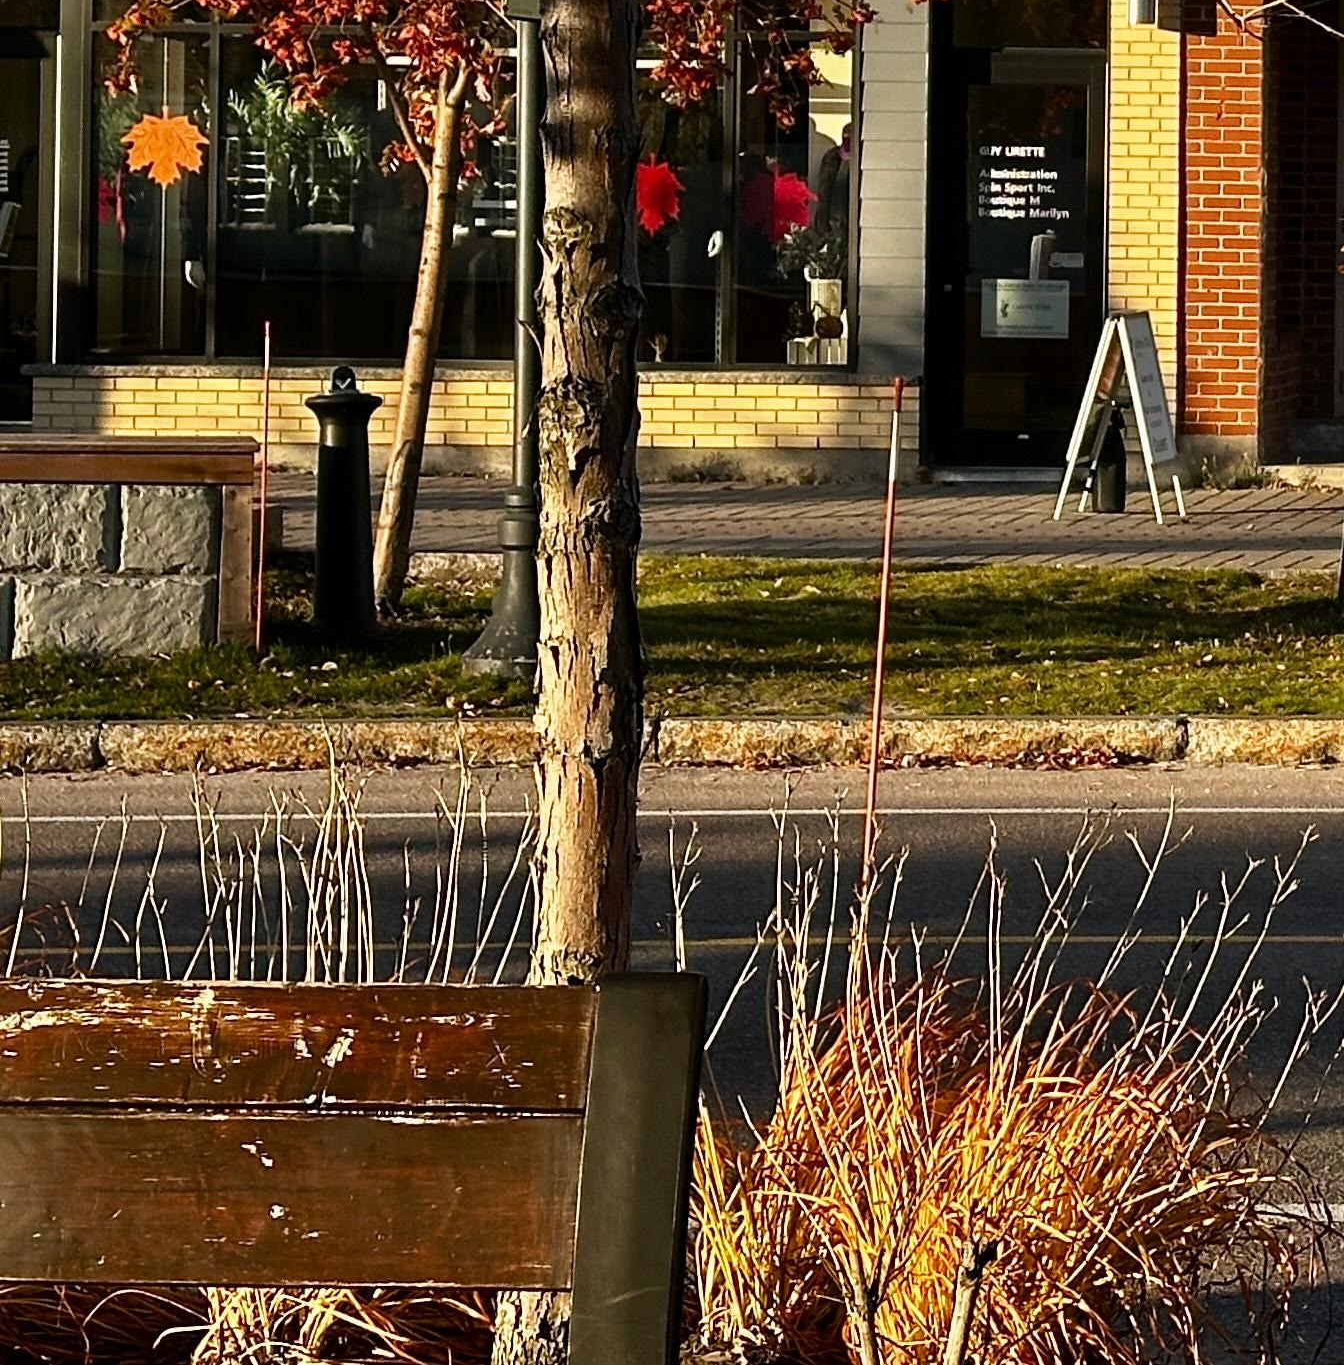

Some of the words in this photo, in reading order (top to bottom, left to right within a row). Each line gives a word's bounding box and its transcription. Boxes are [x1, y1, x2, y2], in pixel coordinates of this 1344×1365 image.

[1004, 181, 1034, 194] Sport
[1037, 182, 1056, 194] Inc.
[1029, 195, 1041, 206] M
[1029, 207, 1070, 221] Marilyn
